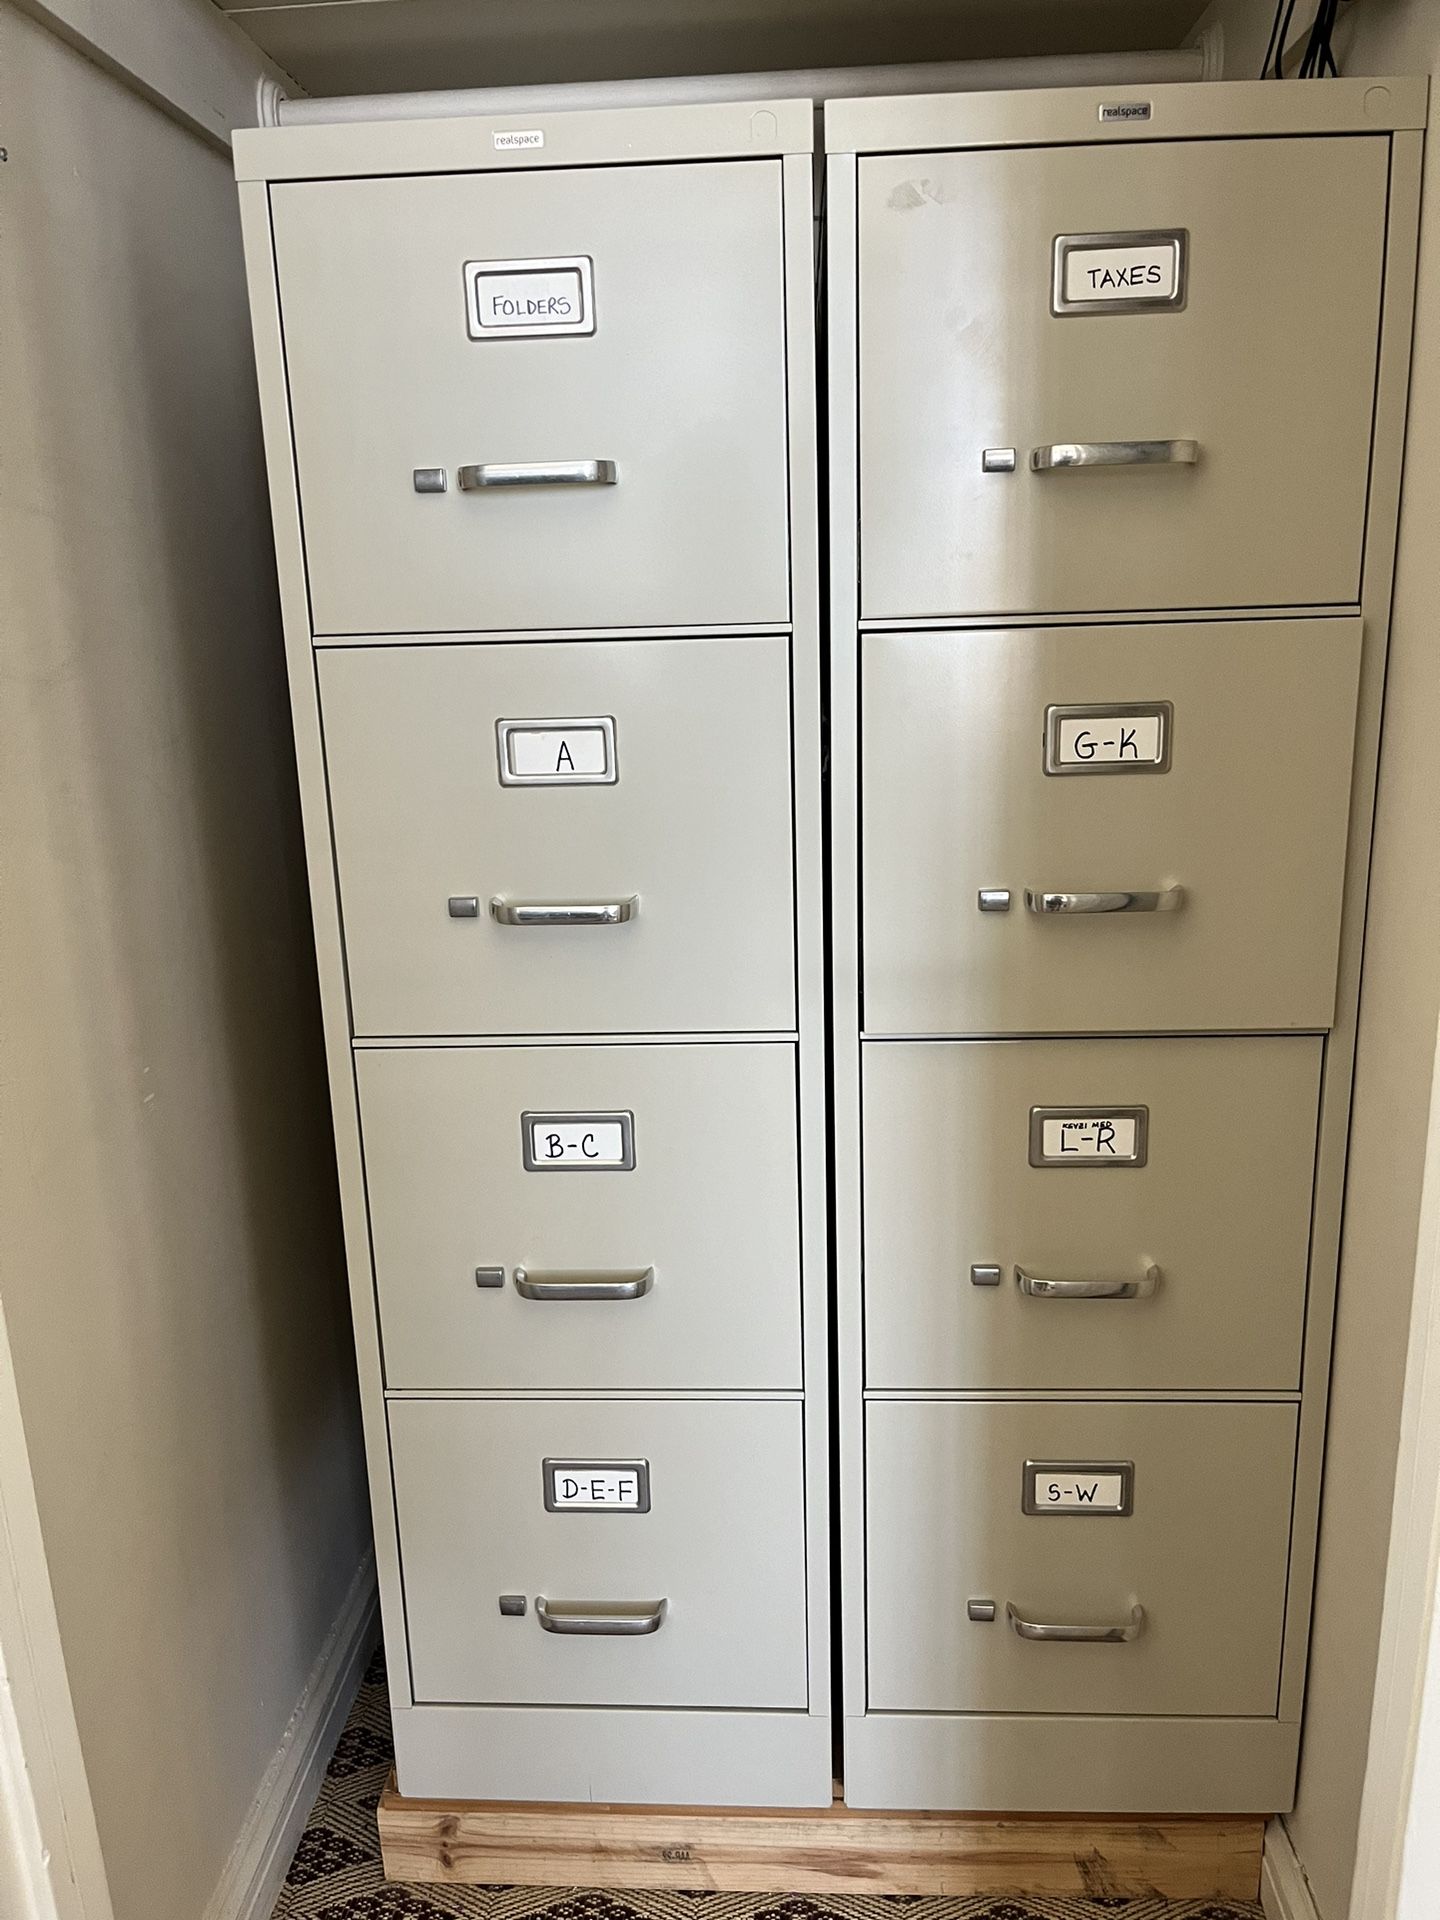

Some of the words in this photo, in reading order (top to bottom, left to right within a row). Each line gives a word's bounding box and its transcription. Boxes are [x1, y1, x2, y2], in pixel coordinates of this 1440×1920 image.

[1102, 105, 1149, 118] realspace
[496, 134, 540, 146] realspace
[1086, 265, 1162, 289] TAXES
[492, 295, 572, 316] FOLDERS
[1074, 727, 1140, 760] G-K
[556, 740, 575, 772] A
[1091, 1120, 1113, 1129] MED
[544, 1133, 600, 1158] B-C
[1060, 1127, 1117, 1154] L-R
[562, 1478, 634, 1502] D-E-F
[1048, 1483, 1099, 1503] S-W
